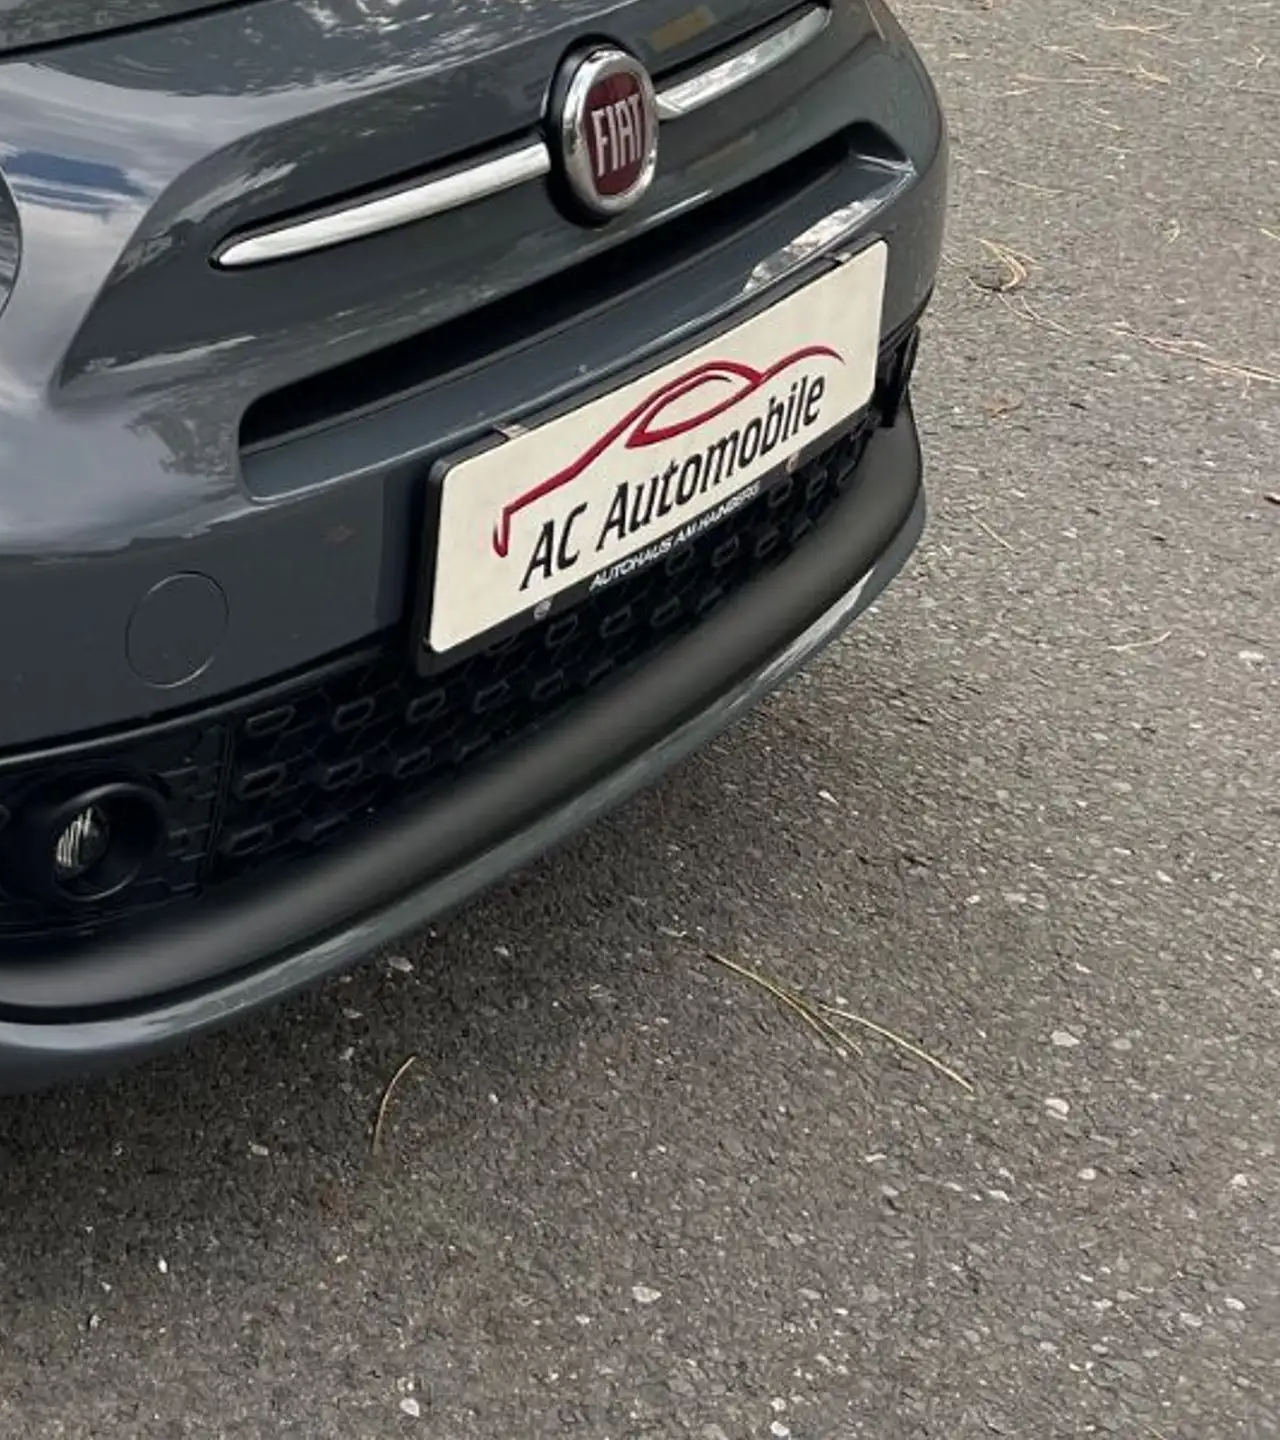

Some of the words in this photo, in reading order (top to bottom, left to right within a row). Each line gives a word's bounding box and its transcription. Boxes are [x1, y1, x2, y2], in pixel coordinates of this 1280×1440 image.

[591, 93, 642, 178] FIAT
[519, 502, 589, 592] AC
[595, 374, 827, 553] Automobile
[589, 533, 674, 592] AUTOHAUS
[673, 522, 698, 548] AM
